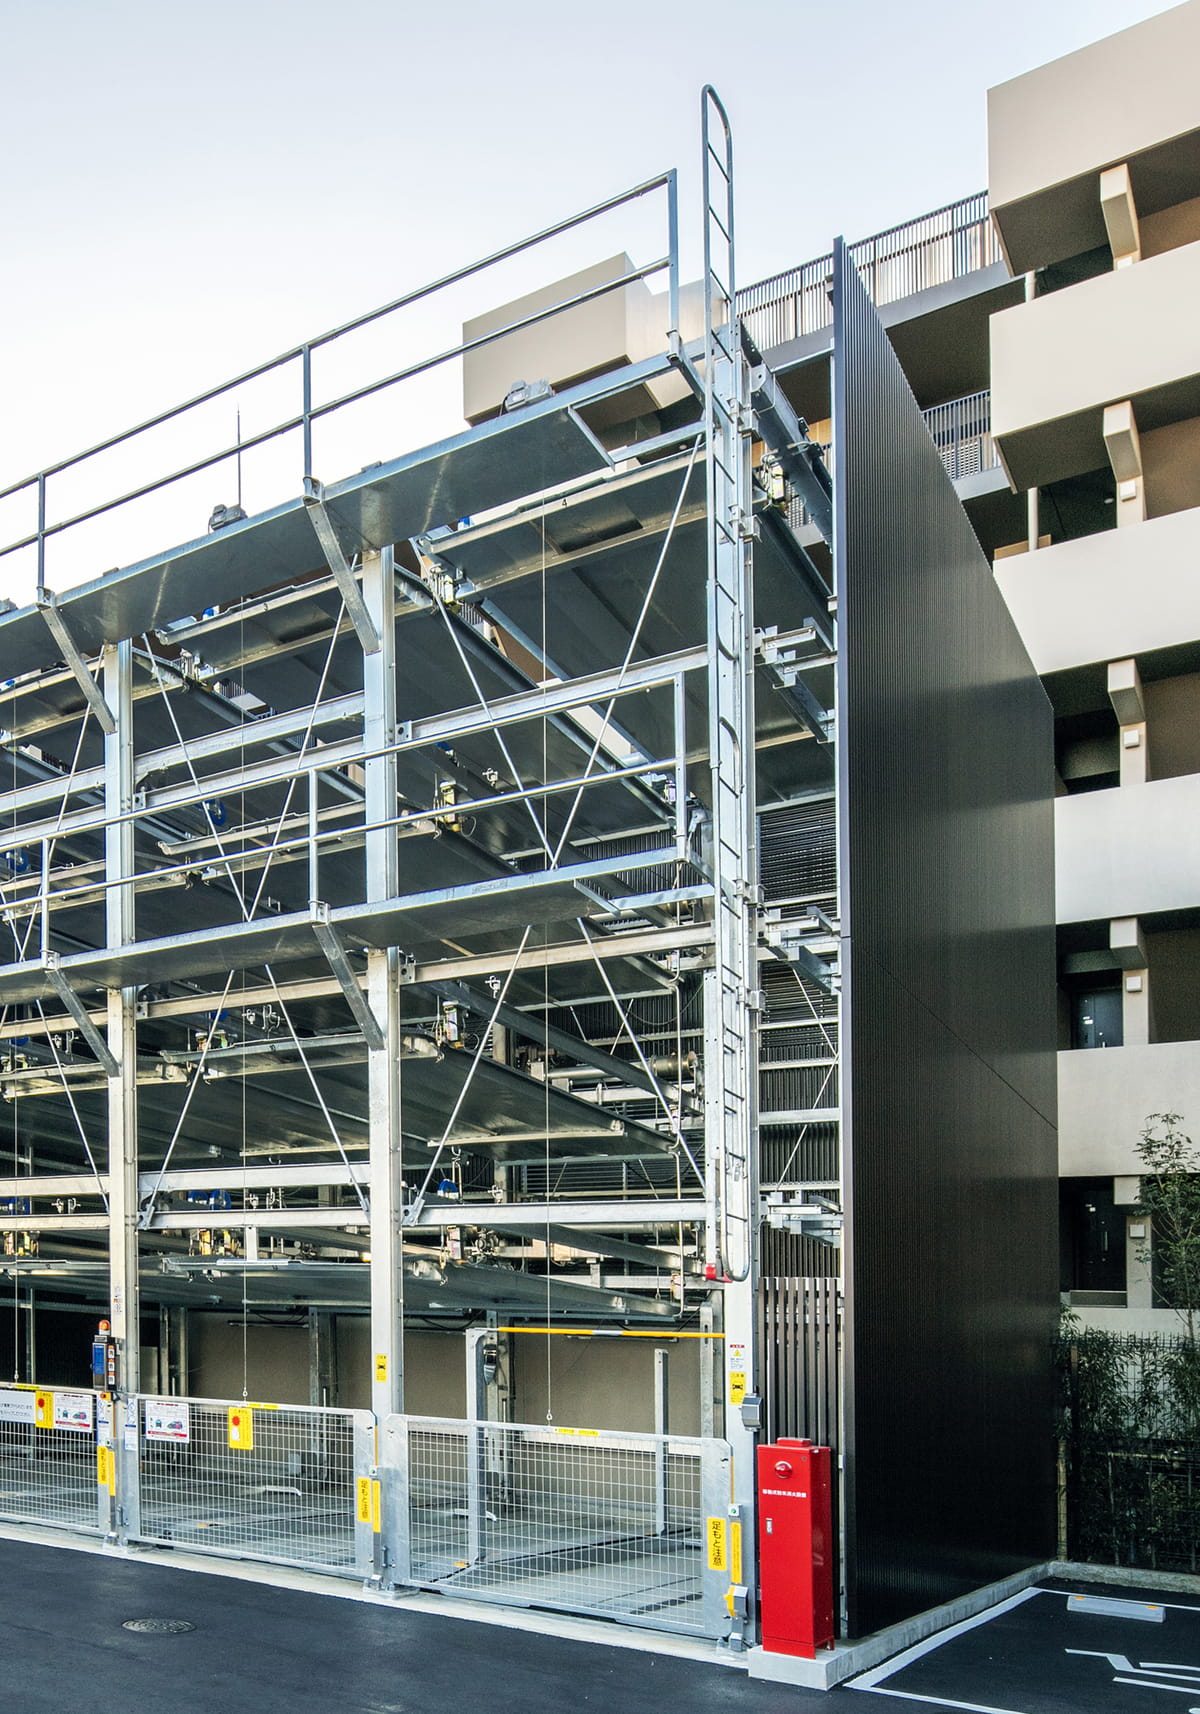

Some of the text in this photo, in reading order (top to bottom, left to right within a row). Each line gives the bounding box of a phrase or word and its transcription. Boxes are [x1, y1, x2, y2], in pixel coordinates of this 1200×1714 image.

[562, 498, 567, 507] 4
[711, 1520, 722, 1567] 足もと注意
